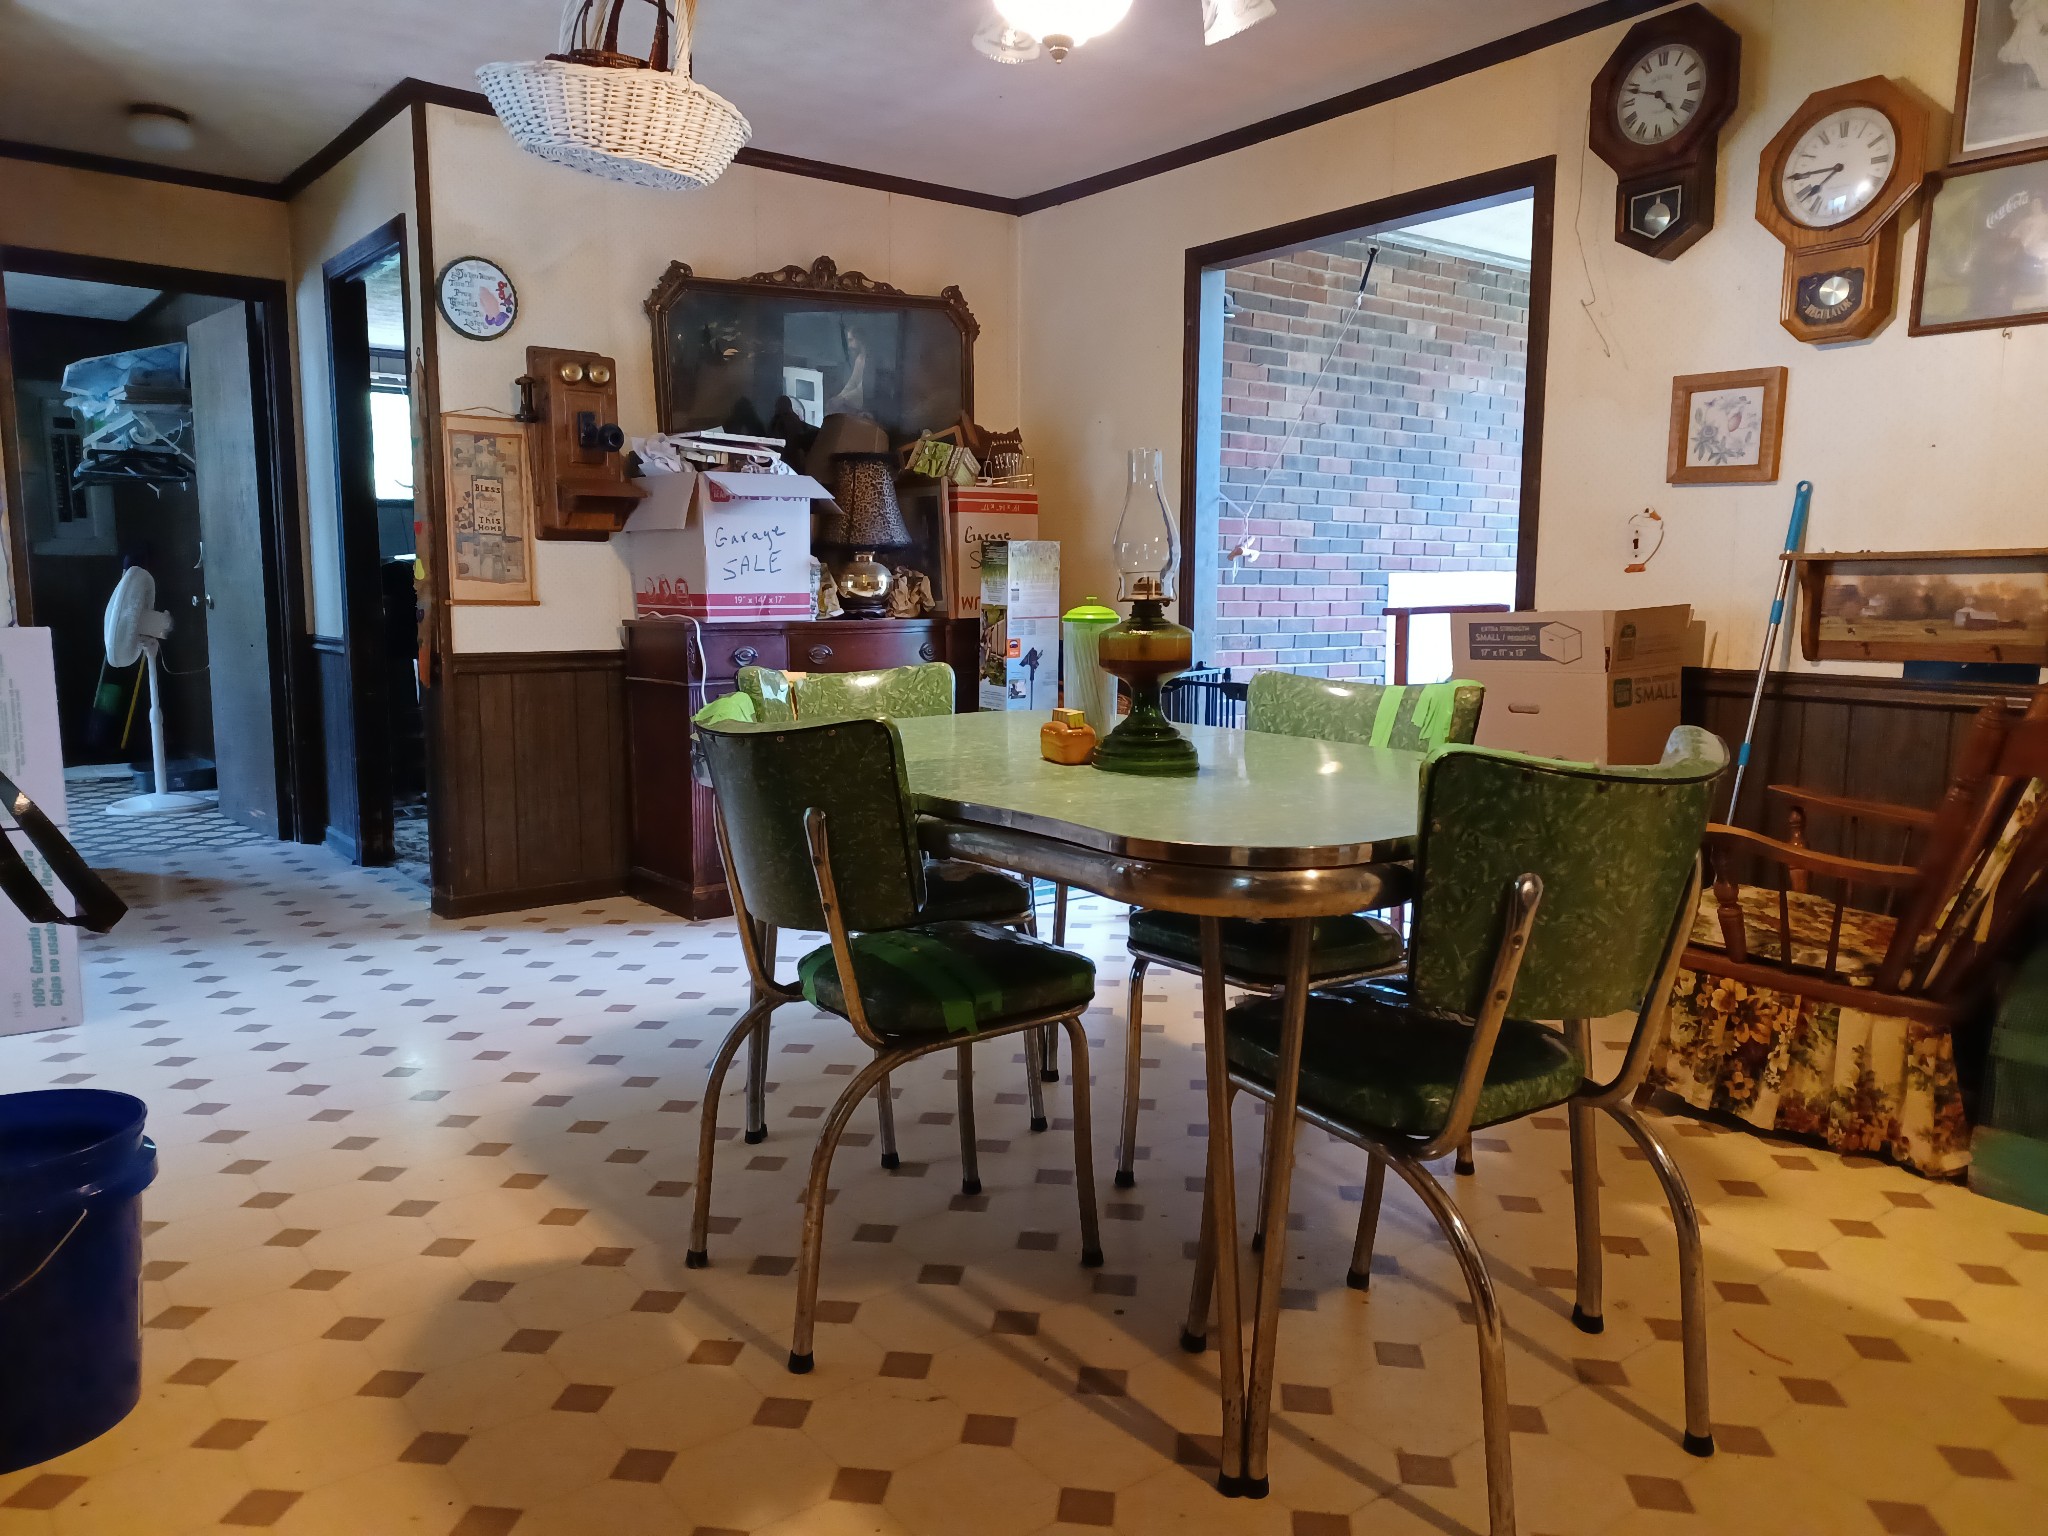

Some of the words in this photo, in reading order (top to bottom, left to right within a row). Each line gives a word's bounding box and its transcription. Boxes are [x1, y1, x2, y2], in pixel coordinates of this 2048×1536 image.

[714, 525, 787, 551] Garage
[722, 549, 782, 581] SALE
[1475, 633, 1501, 642] SMALL
[1634, 682, 1678, 704] SMALL
[45, 921, 59, 955] usada
[49, 958, 61, 973] no
[32, 977, 46, 1009] 100%
[50, 976, 65, 1007] Cajas
